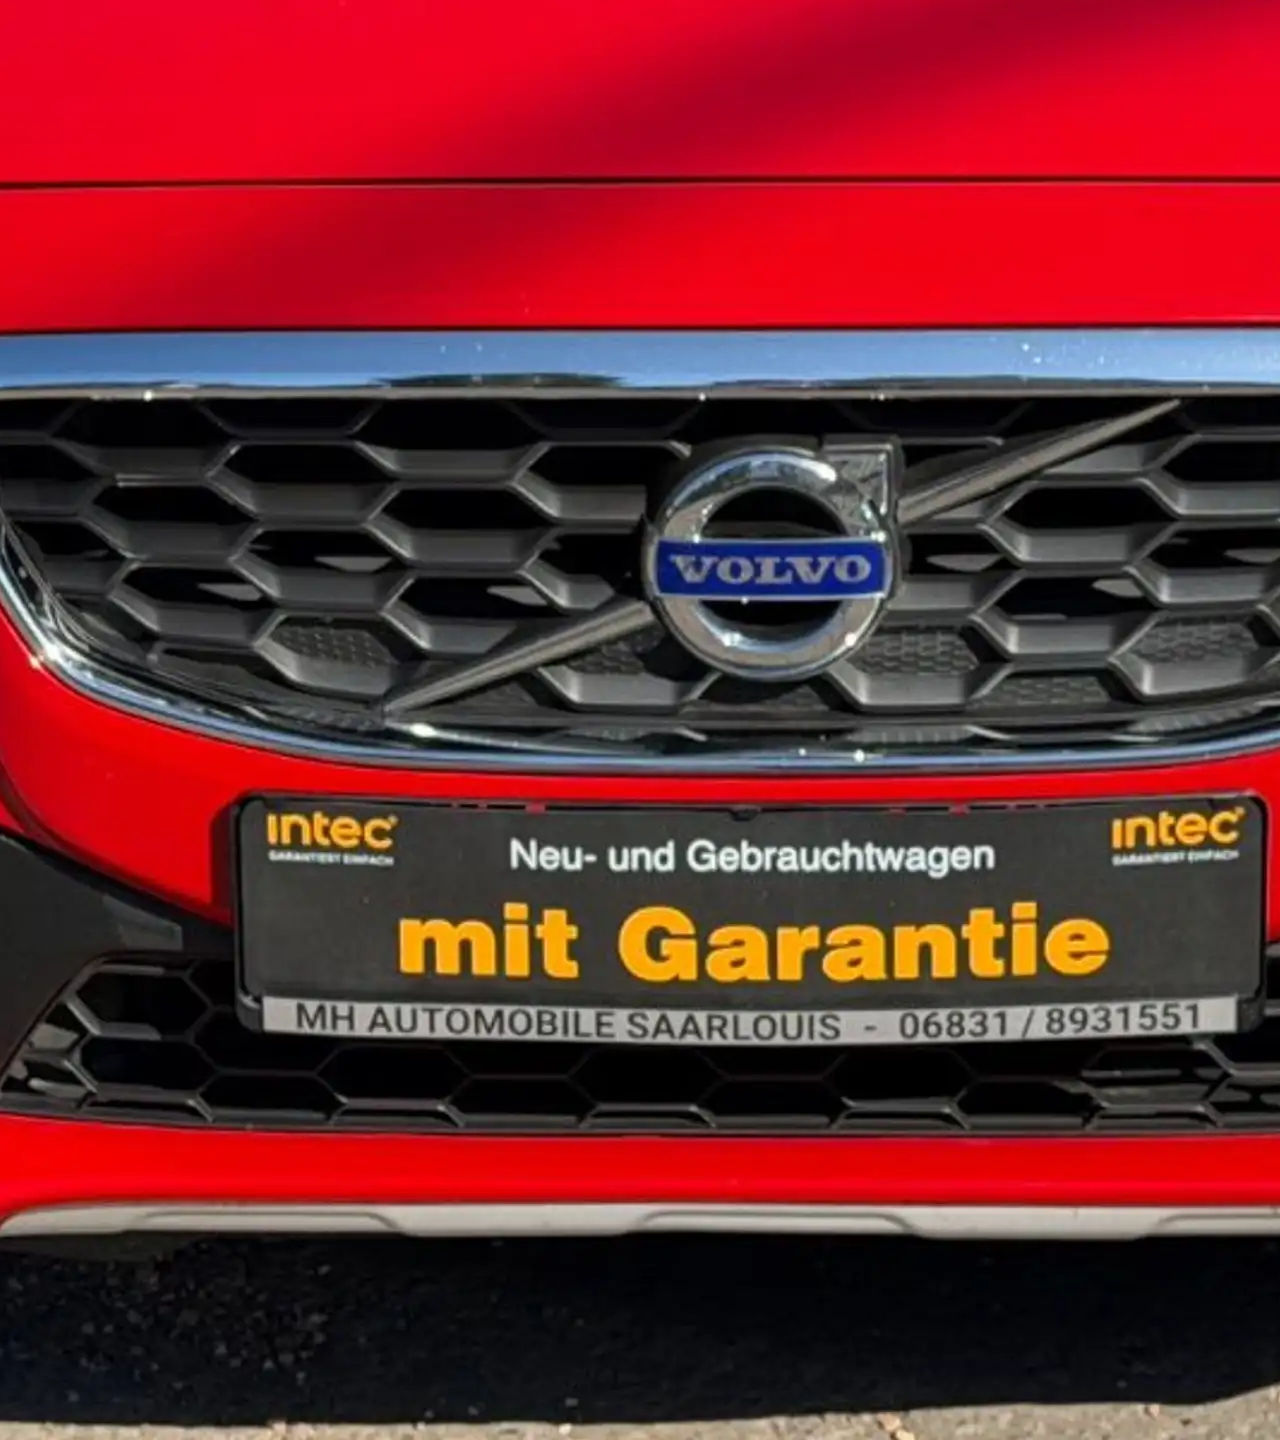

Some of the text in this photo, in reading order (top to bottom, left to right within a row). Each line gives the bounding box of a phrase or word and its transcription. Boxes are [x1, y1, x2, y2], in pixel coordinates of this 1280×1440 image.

[670, 554, 872, 584] VOLVO
[510, 837, 996, 879] Neu- und Gebrauchtwagen
[397, 900, 1112, 985] mit Garantie
[295, 1002, 355, 1032] MH
[367, 1006, 616, 1038] AUTOMOBILE
[626, 1011, 842, 1042] SAARLOUIS
[899, 1010, 1008, 1040] 06831
[1045, 1002, 1202, 1035] 8931551
